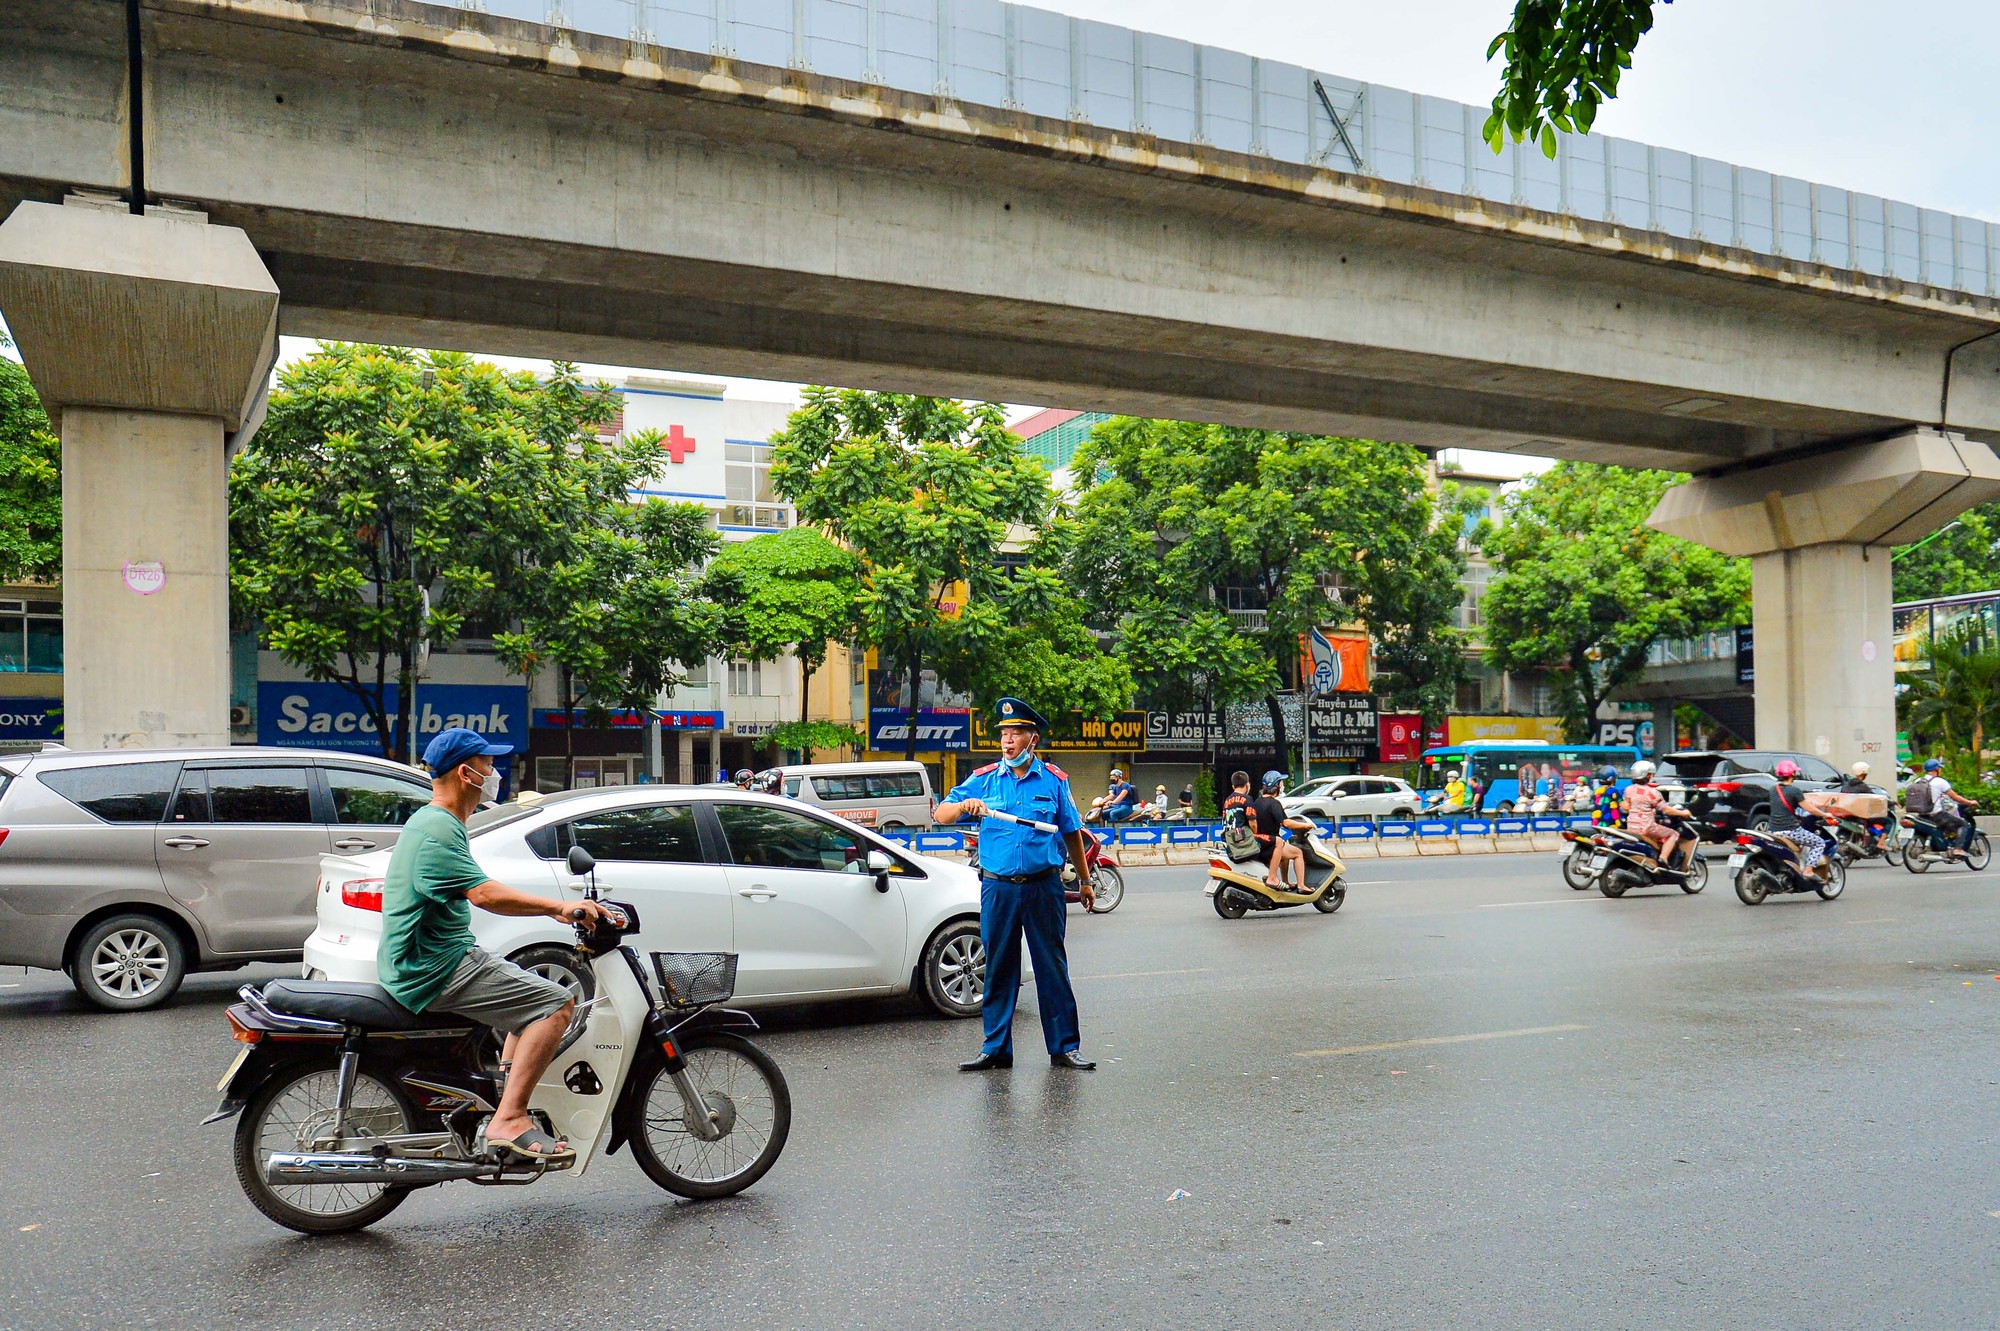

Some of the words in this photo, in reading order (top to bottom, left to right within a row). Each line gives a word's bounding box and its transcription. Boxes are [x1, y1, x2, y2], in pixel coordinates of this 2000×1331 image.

[129, 568, 160, 581] DR26
[1349, 699, 1369, 708] Linh
[1176, 713, 1217, 725] STYLE
[1310, 711, 1341, 727] Nail
[1344, 714, 1354, 727] &
[1356, 711, 1375, 727] Mi
[1082, 716, 1106, 738] HẢI
[1110, 721, 1142, 740] QUY
[1171, 726, 1223, 739] MOBILE
